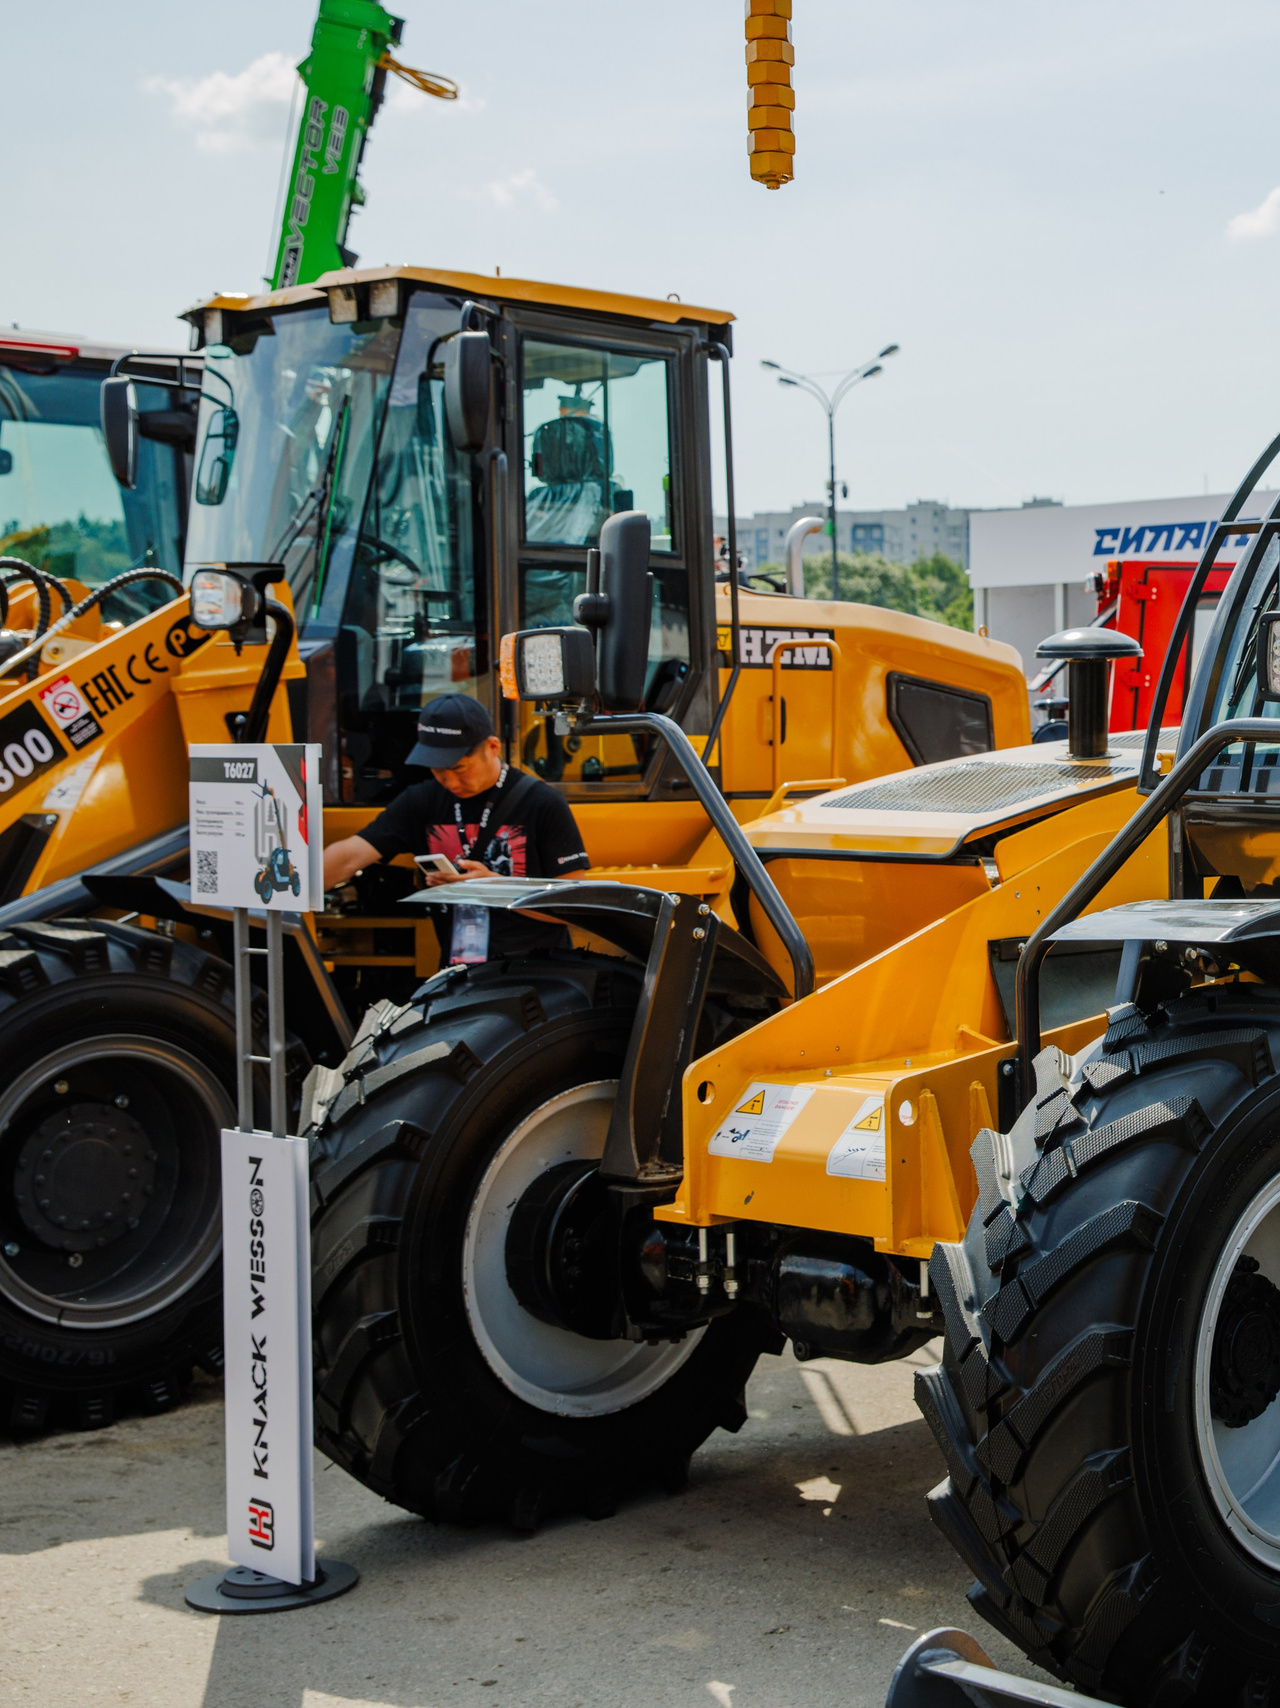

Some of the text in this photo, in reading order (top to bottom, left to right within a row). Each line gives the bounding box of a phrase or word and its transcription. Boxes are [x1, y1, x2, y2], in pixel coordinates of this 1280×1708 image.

[285, 96, 328, 248] VECTOR
[739, 629, 830, 665] HZM
[223, 762, 255, 779] T6027
[248, 1156, 269, 1479] KNACK WESSON
